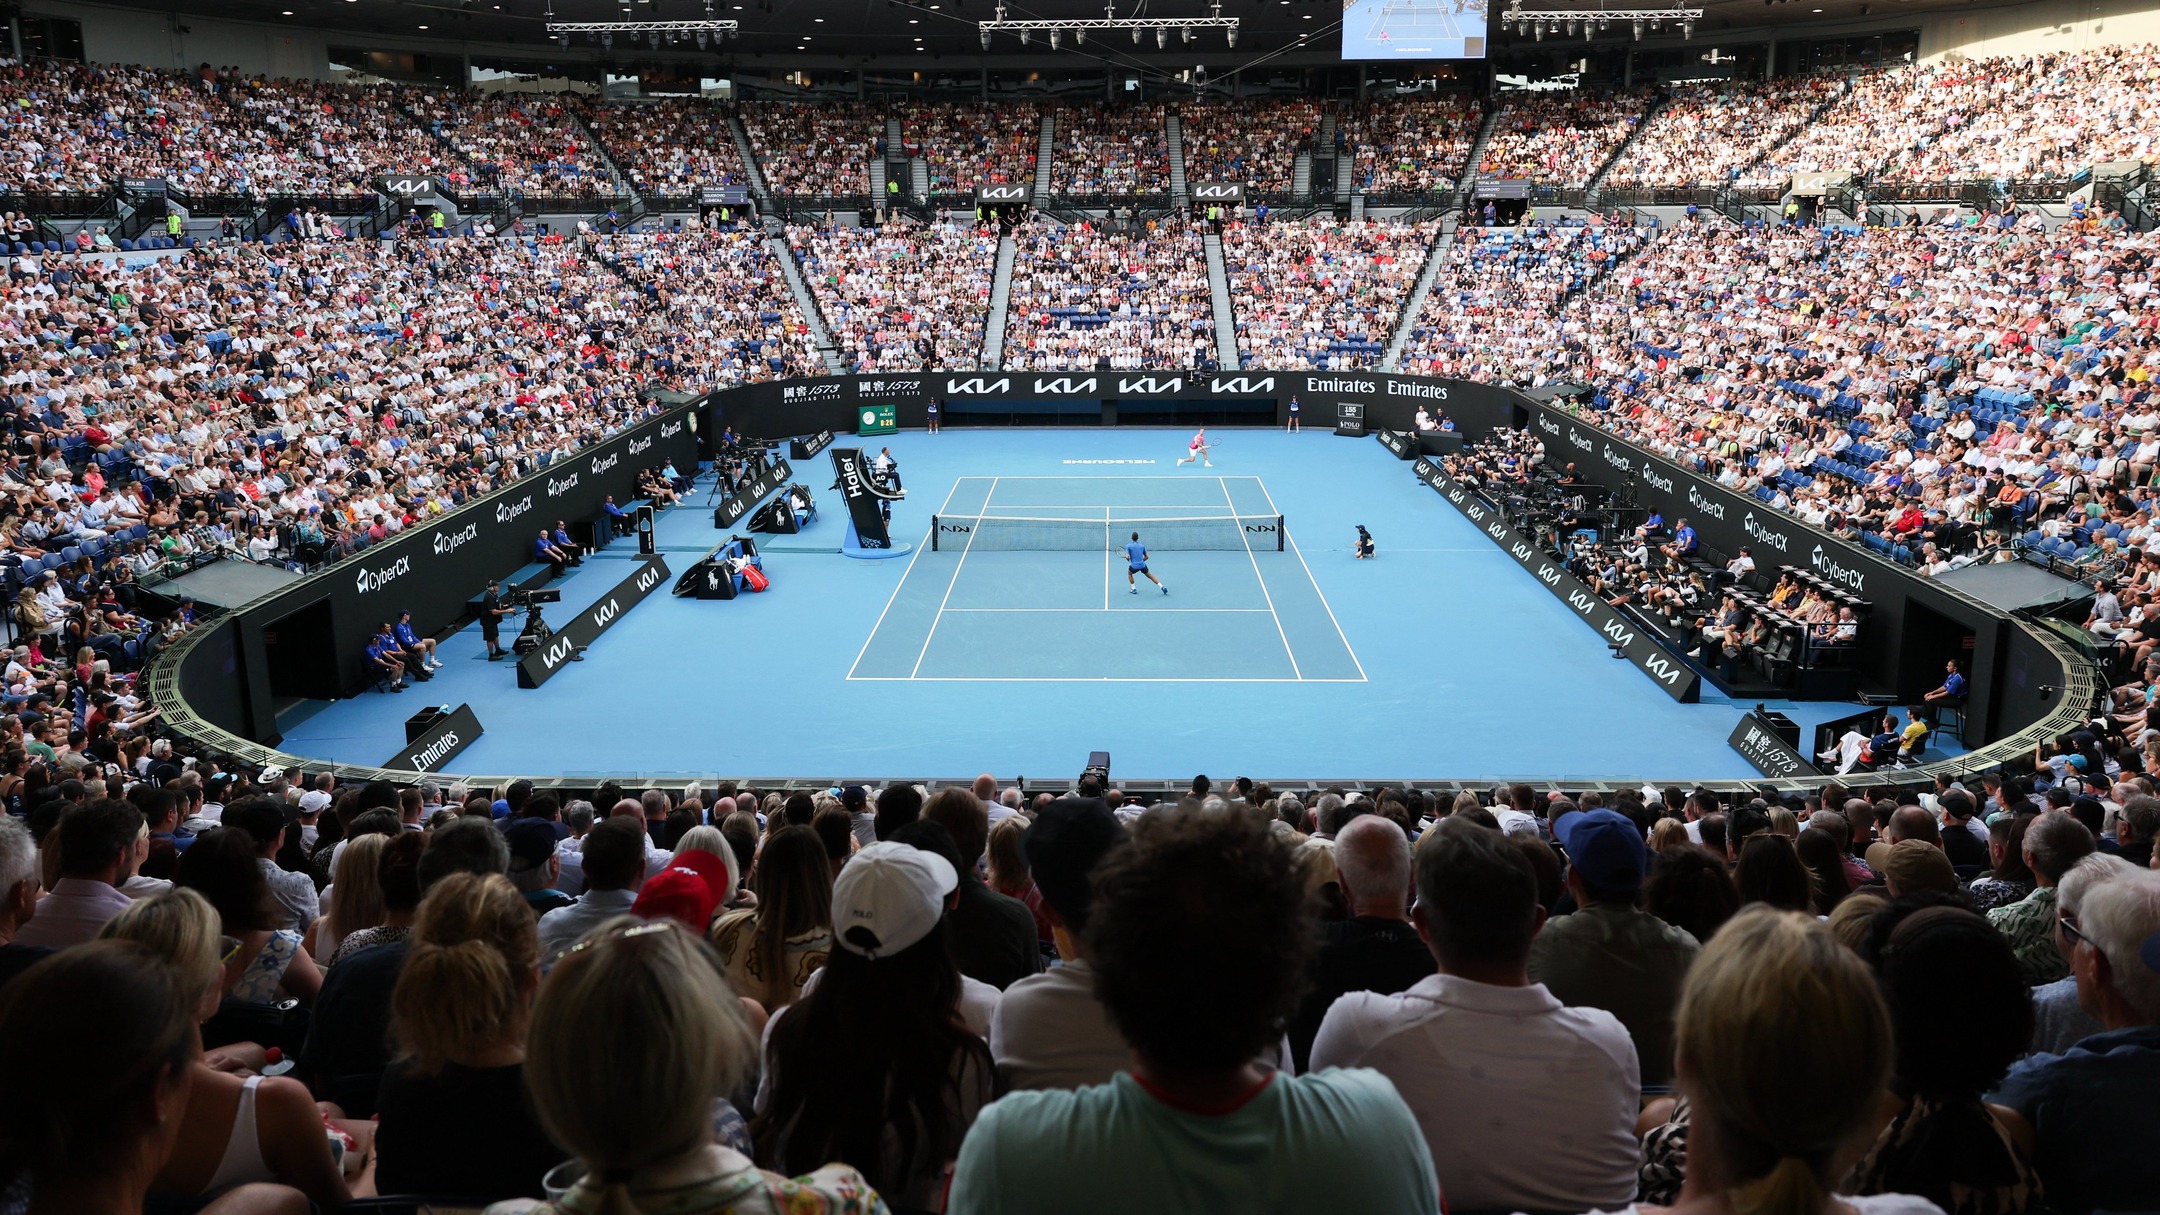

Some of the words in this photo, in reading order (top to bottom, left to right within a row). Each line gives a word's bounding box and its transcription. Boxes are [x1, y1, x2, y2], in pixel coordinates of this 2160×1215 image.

[386, 180, 429, 193] KIA
[983, 187, 1024, 198] KIA
[1196, 185, 1238, 197] KIA
[808, 383, 841, 396] 1573
[886, 380, 921, 391] 1573
[947, 378, 1010, 394] KIA
[1034, 378, 1097, 394] KIA
[1119, 377, 1182, 393] KIA
[1211, 377, 1275, 393] KIA
[1307, 377, 1376, 394] Emirates
[1387, 380, 1448, 400] Emirates
[784, 396, 817, 404] GUOJIAO
[665, 420, 681, 439] CyberCX
[1543, 417, 1560, 436] CyberCX
[634, 435, 652, 456] CyberCX
[1574, 434, 1592, 453] CyberCX
[597, 452, 618, 474] CyberCX
[1416, 461, 1430, 476] KIA
[1609, 450, 1630, 471] CyberCX
[554, 472, 579, 496] CyberCX
[773, 466, 786, 482] KIA
[841, 458, 862, 498] Haier
[1431, 474, 1447, 489] KIA
[1649, 470, 1673, 495] CyberCX
[752, 482, 767, 499] KIA
[1448, 488, 1465, 505] KIA
[504, 495, 532, 522] CyberCX
[728, 500, 745, 518] KIA
[1467, 504, 1485, 522] KIA
[1696, 493, 1725, 521] CyberCX
[444, 522, 477, 553] CyberCX
[1487, 521, 1507, 541] KIA
[1752, 521, 1788, 552] CyberCX
[1511, 541, 1533, 562] KIA
[369, 555, 410, 591] CyberCX
[637, 567, 659, 592] KIA
[1538, 563, 1561, 586] KIA
[1822, 555, 1865, 592] CyberCX
[1568, 588, 1595, 615] KIA
[594, 598, 620, 627] KIA
[1603, 618, 1634, 647] KIA
[542, 636, 573, 669] KIA
[1645, 652, 1680, 685] KIA
[411, 730, 459, 772] Emirates
[1740, 741, 1769, 768] GUOJIAO
[1765, 747, 1798, 773] 1573
